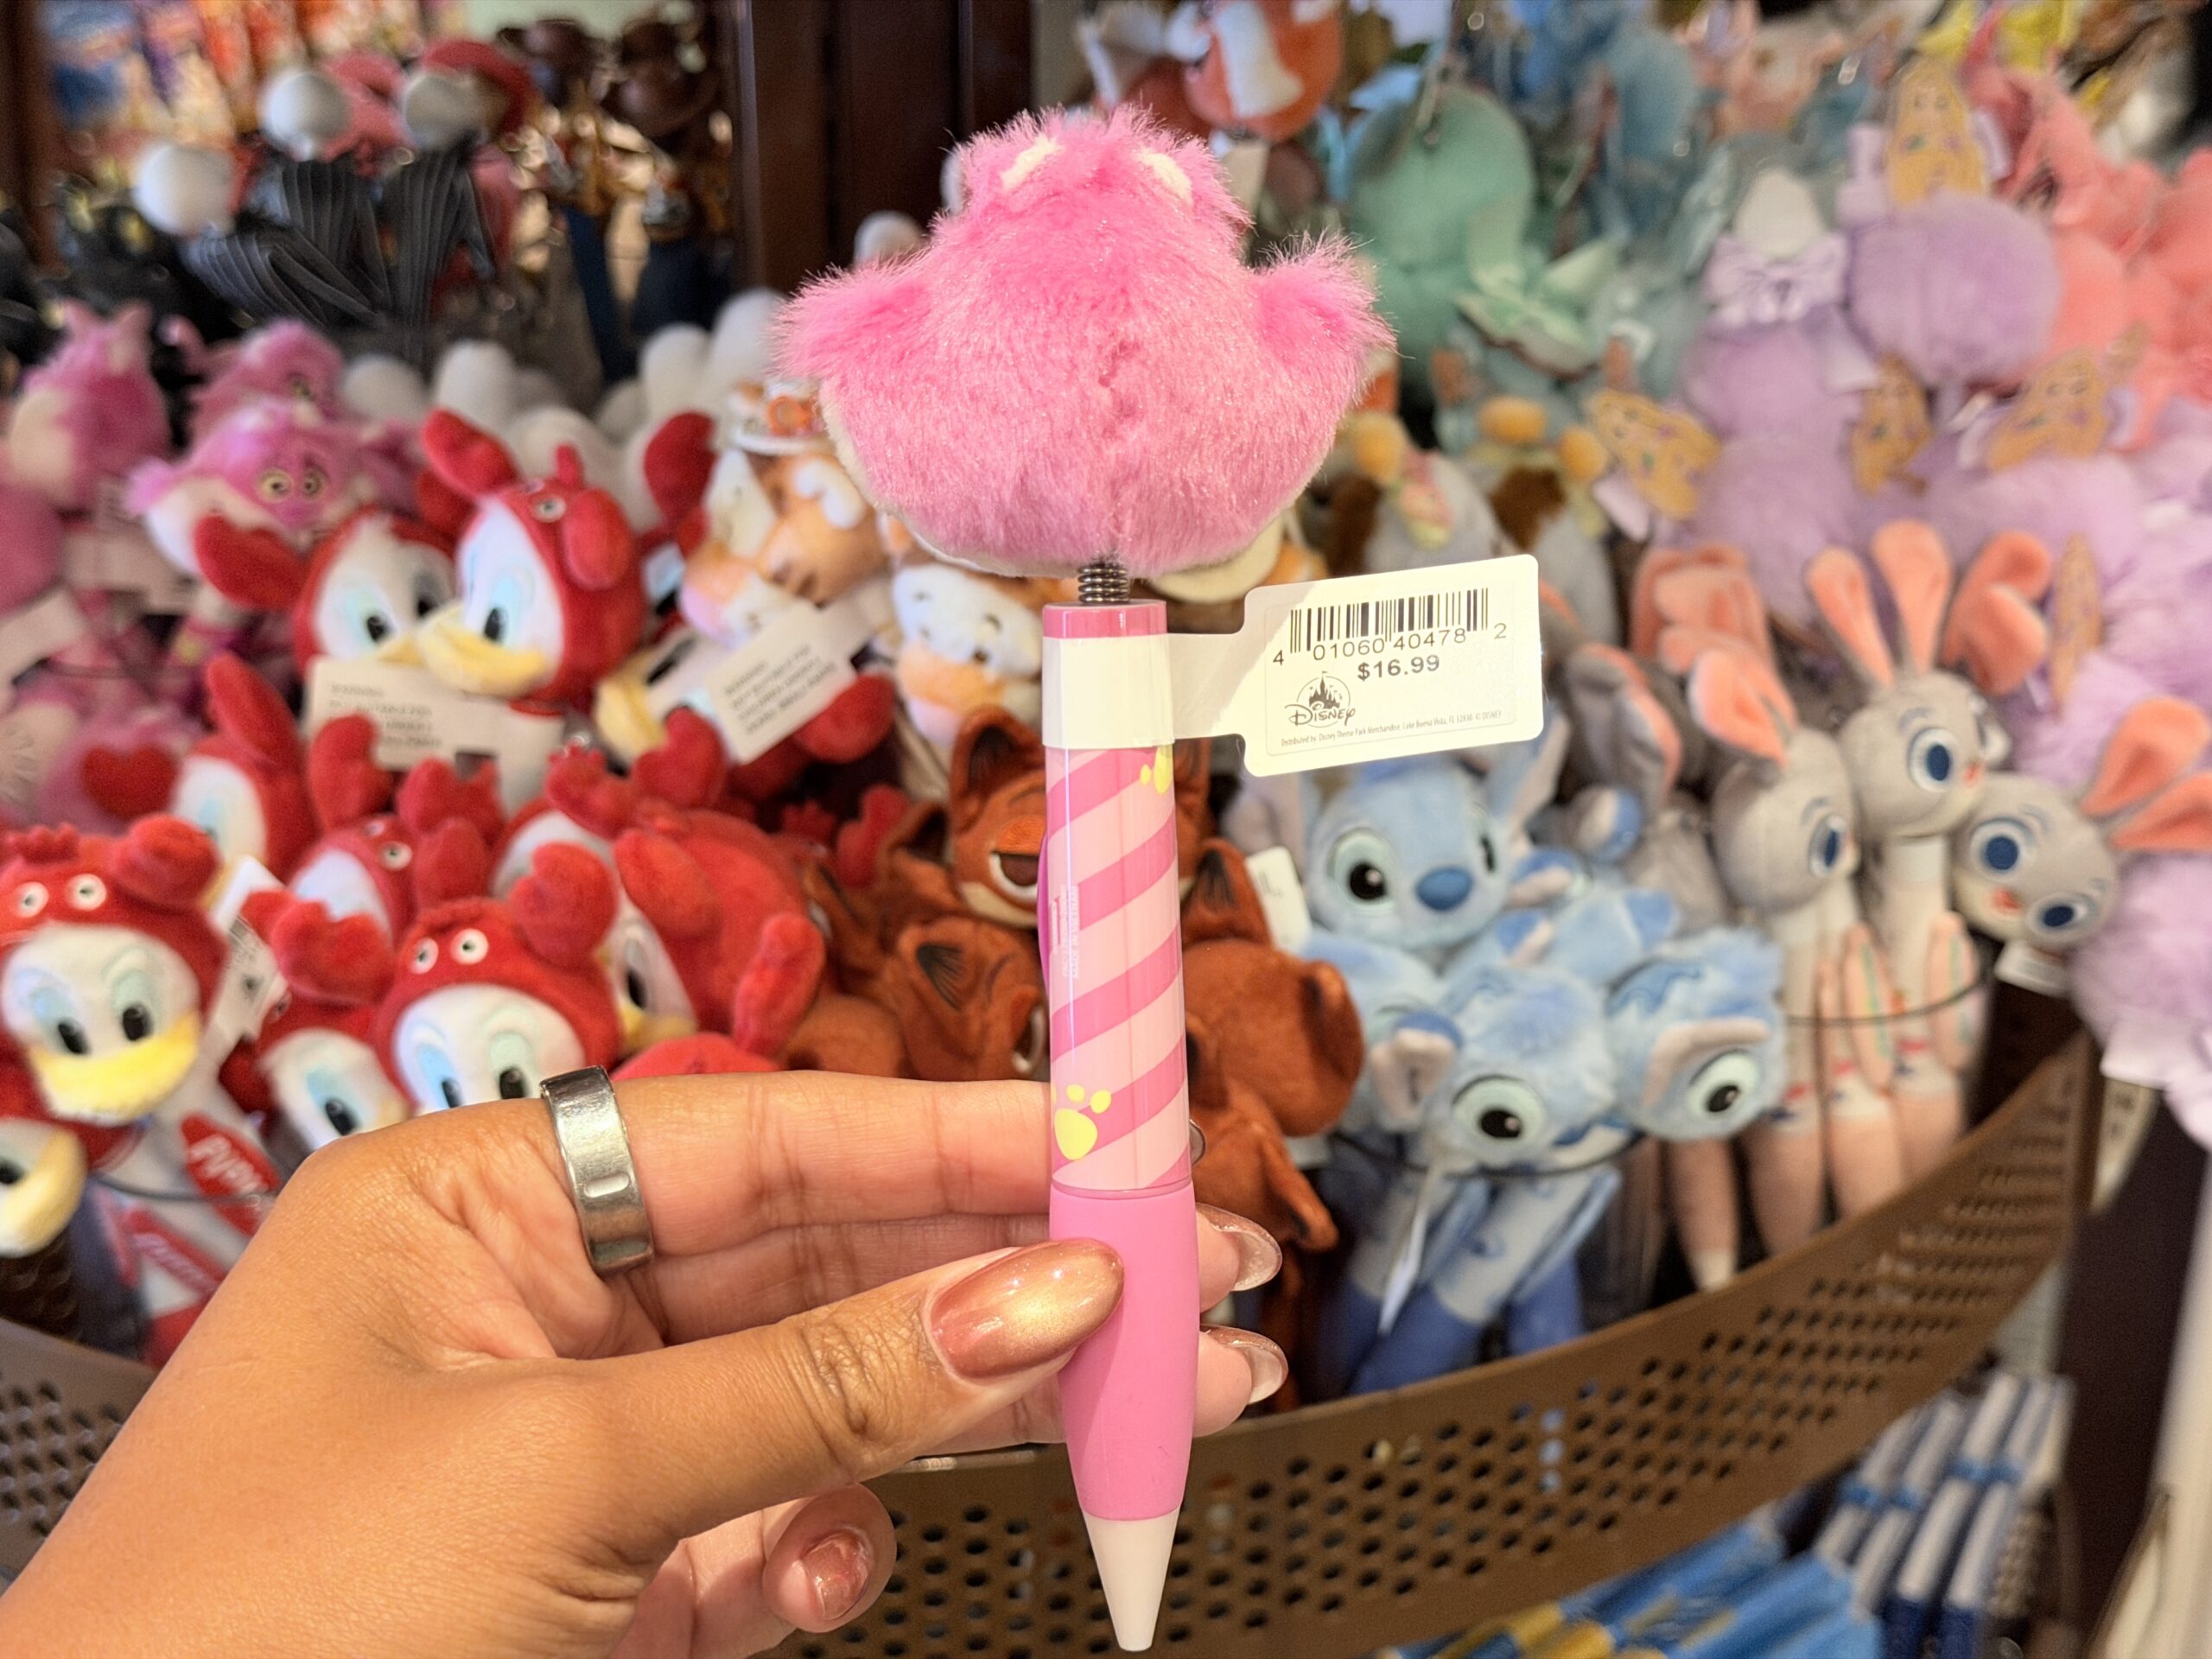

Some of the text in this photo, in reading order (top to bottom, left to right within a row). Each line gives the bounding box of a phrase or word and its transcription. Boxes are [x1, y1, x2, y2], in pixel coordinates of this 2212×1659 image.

[1273, 622, 1507, 665] 4 01060 40478 2
[1357, 654, 1440, 682] $16.99
[1319, 732, 1336, 741] Disney
[1482, 709, 1502, 720] DISNEY
